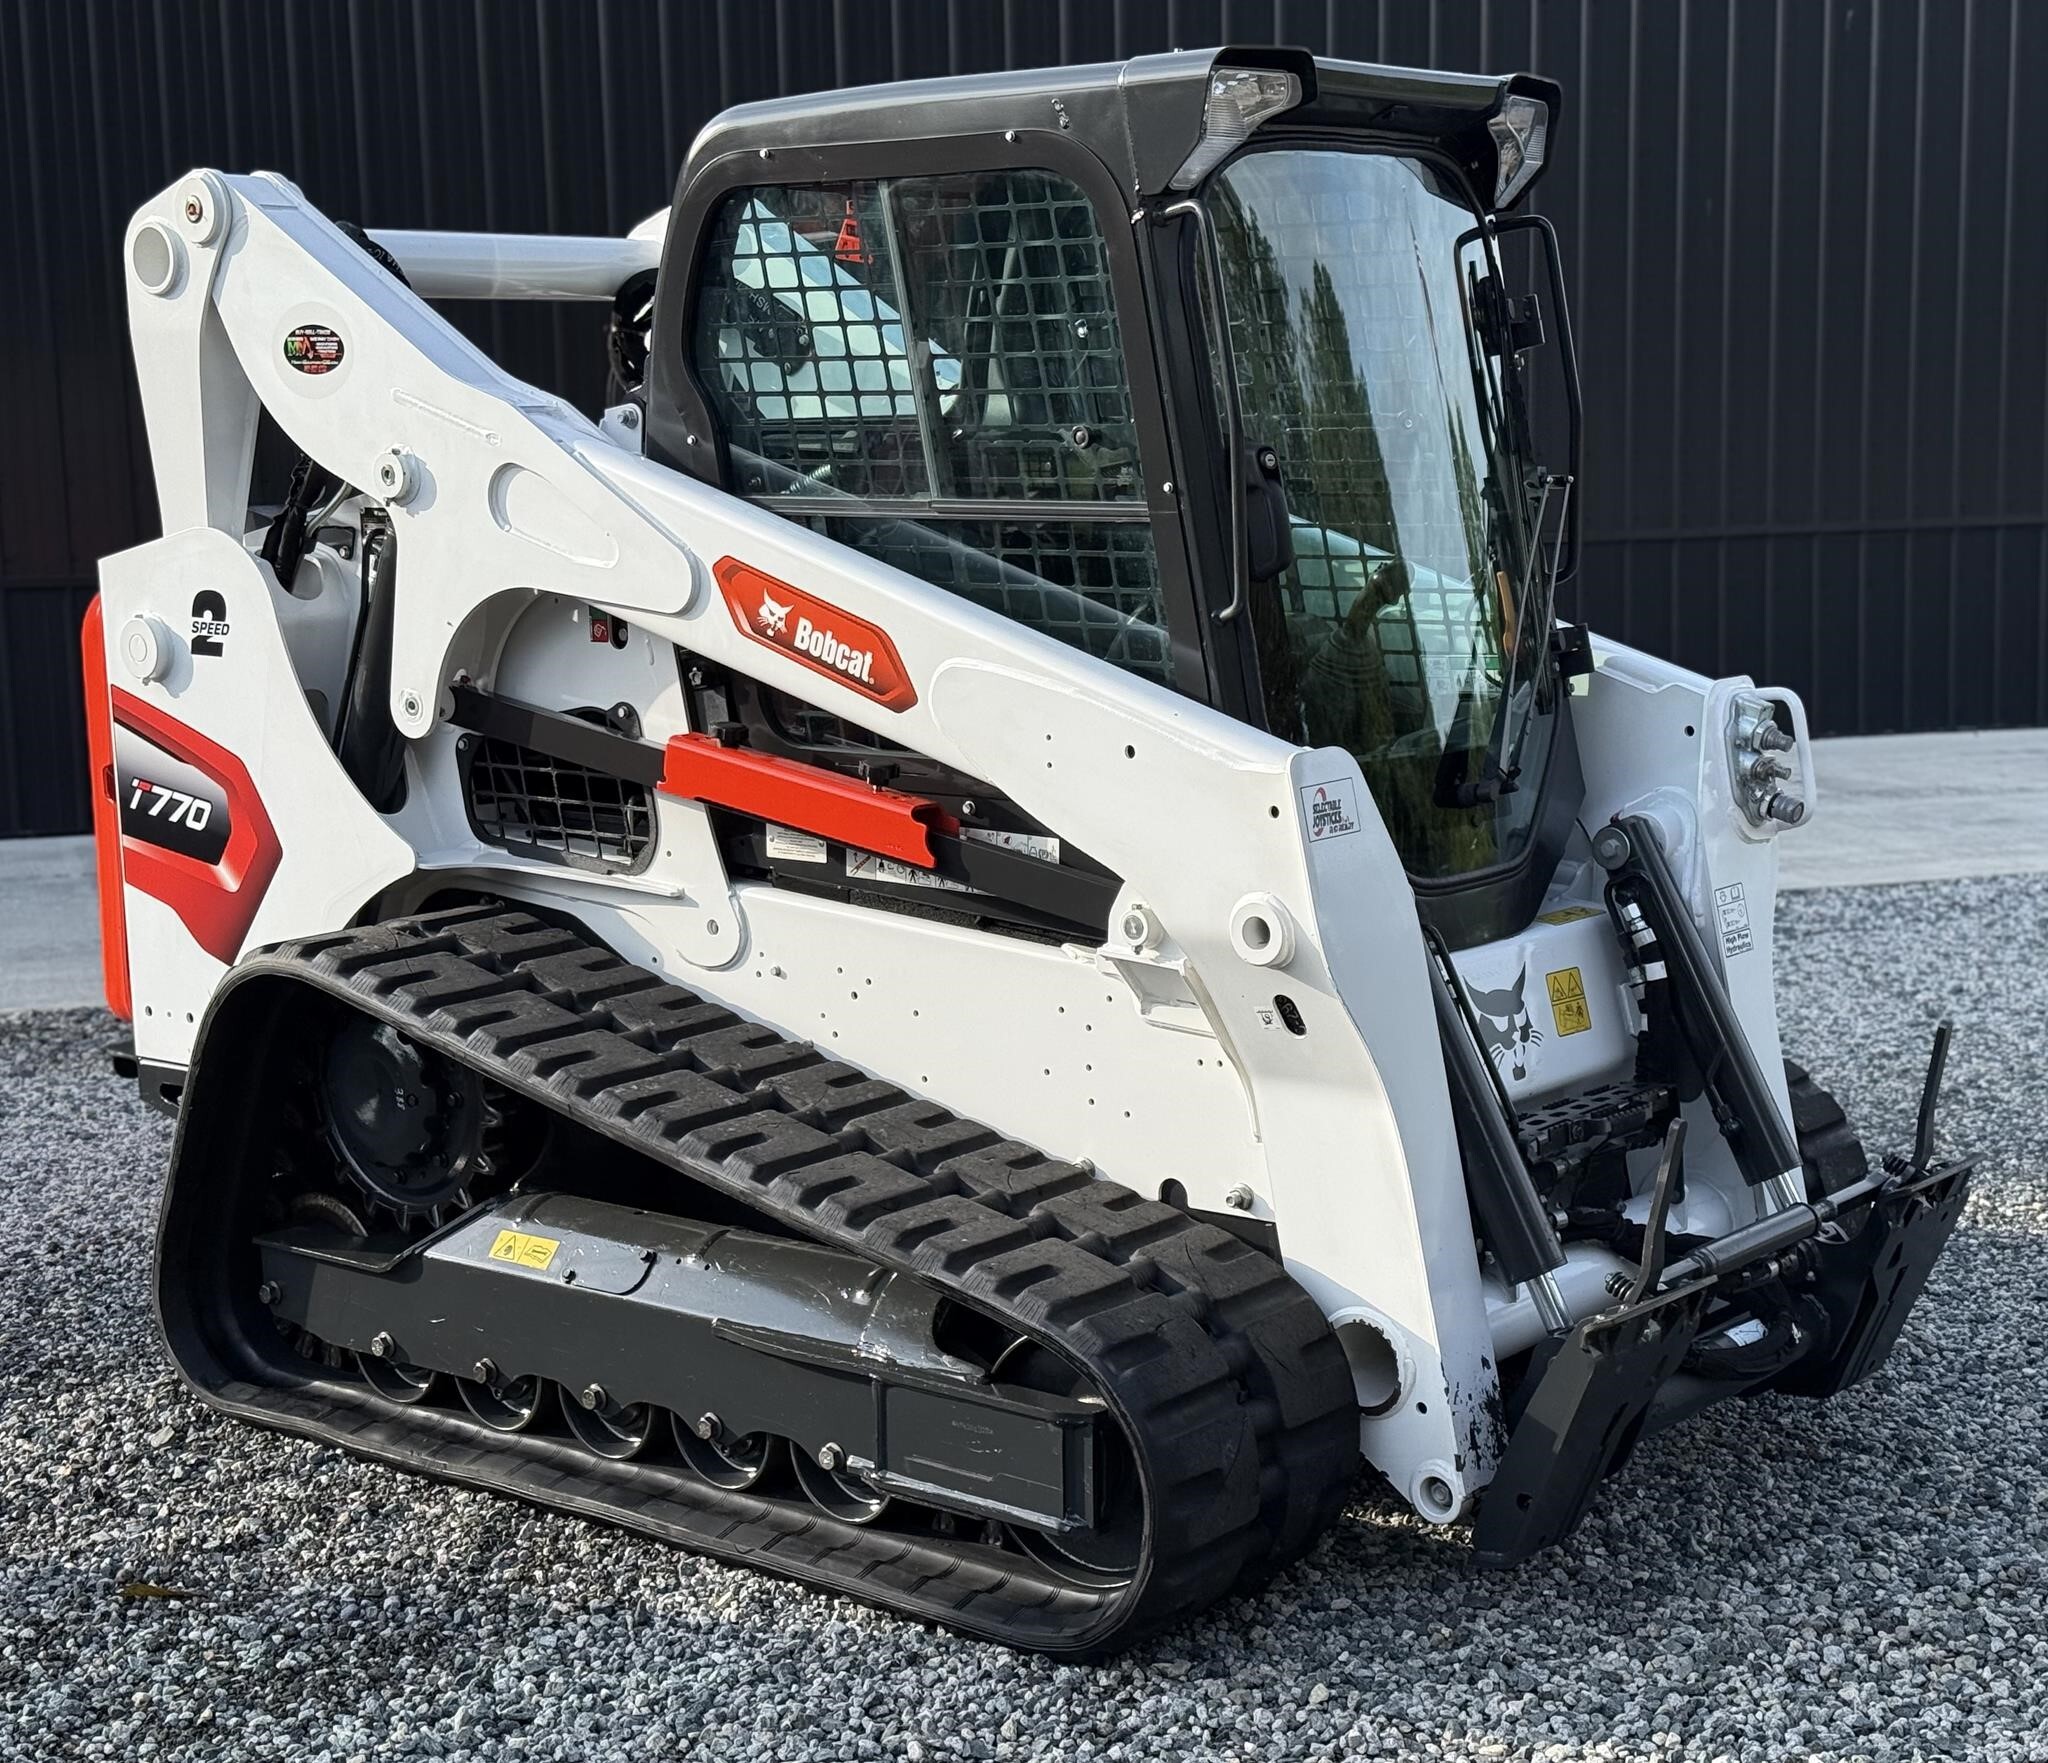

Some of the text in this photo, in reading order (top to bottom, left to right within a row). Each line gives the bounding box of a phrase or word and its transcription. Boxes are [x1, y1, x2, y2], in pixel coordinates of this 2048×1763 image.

[191, 590, 226, 657] 2
[191, 621, 230, 636] SPEED
[794, 616, 873, 683] Bobcat
[130, 778, 212, 831] T770
